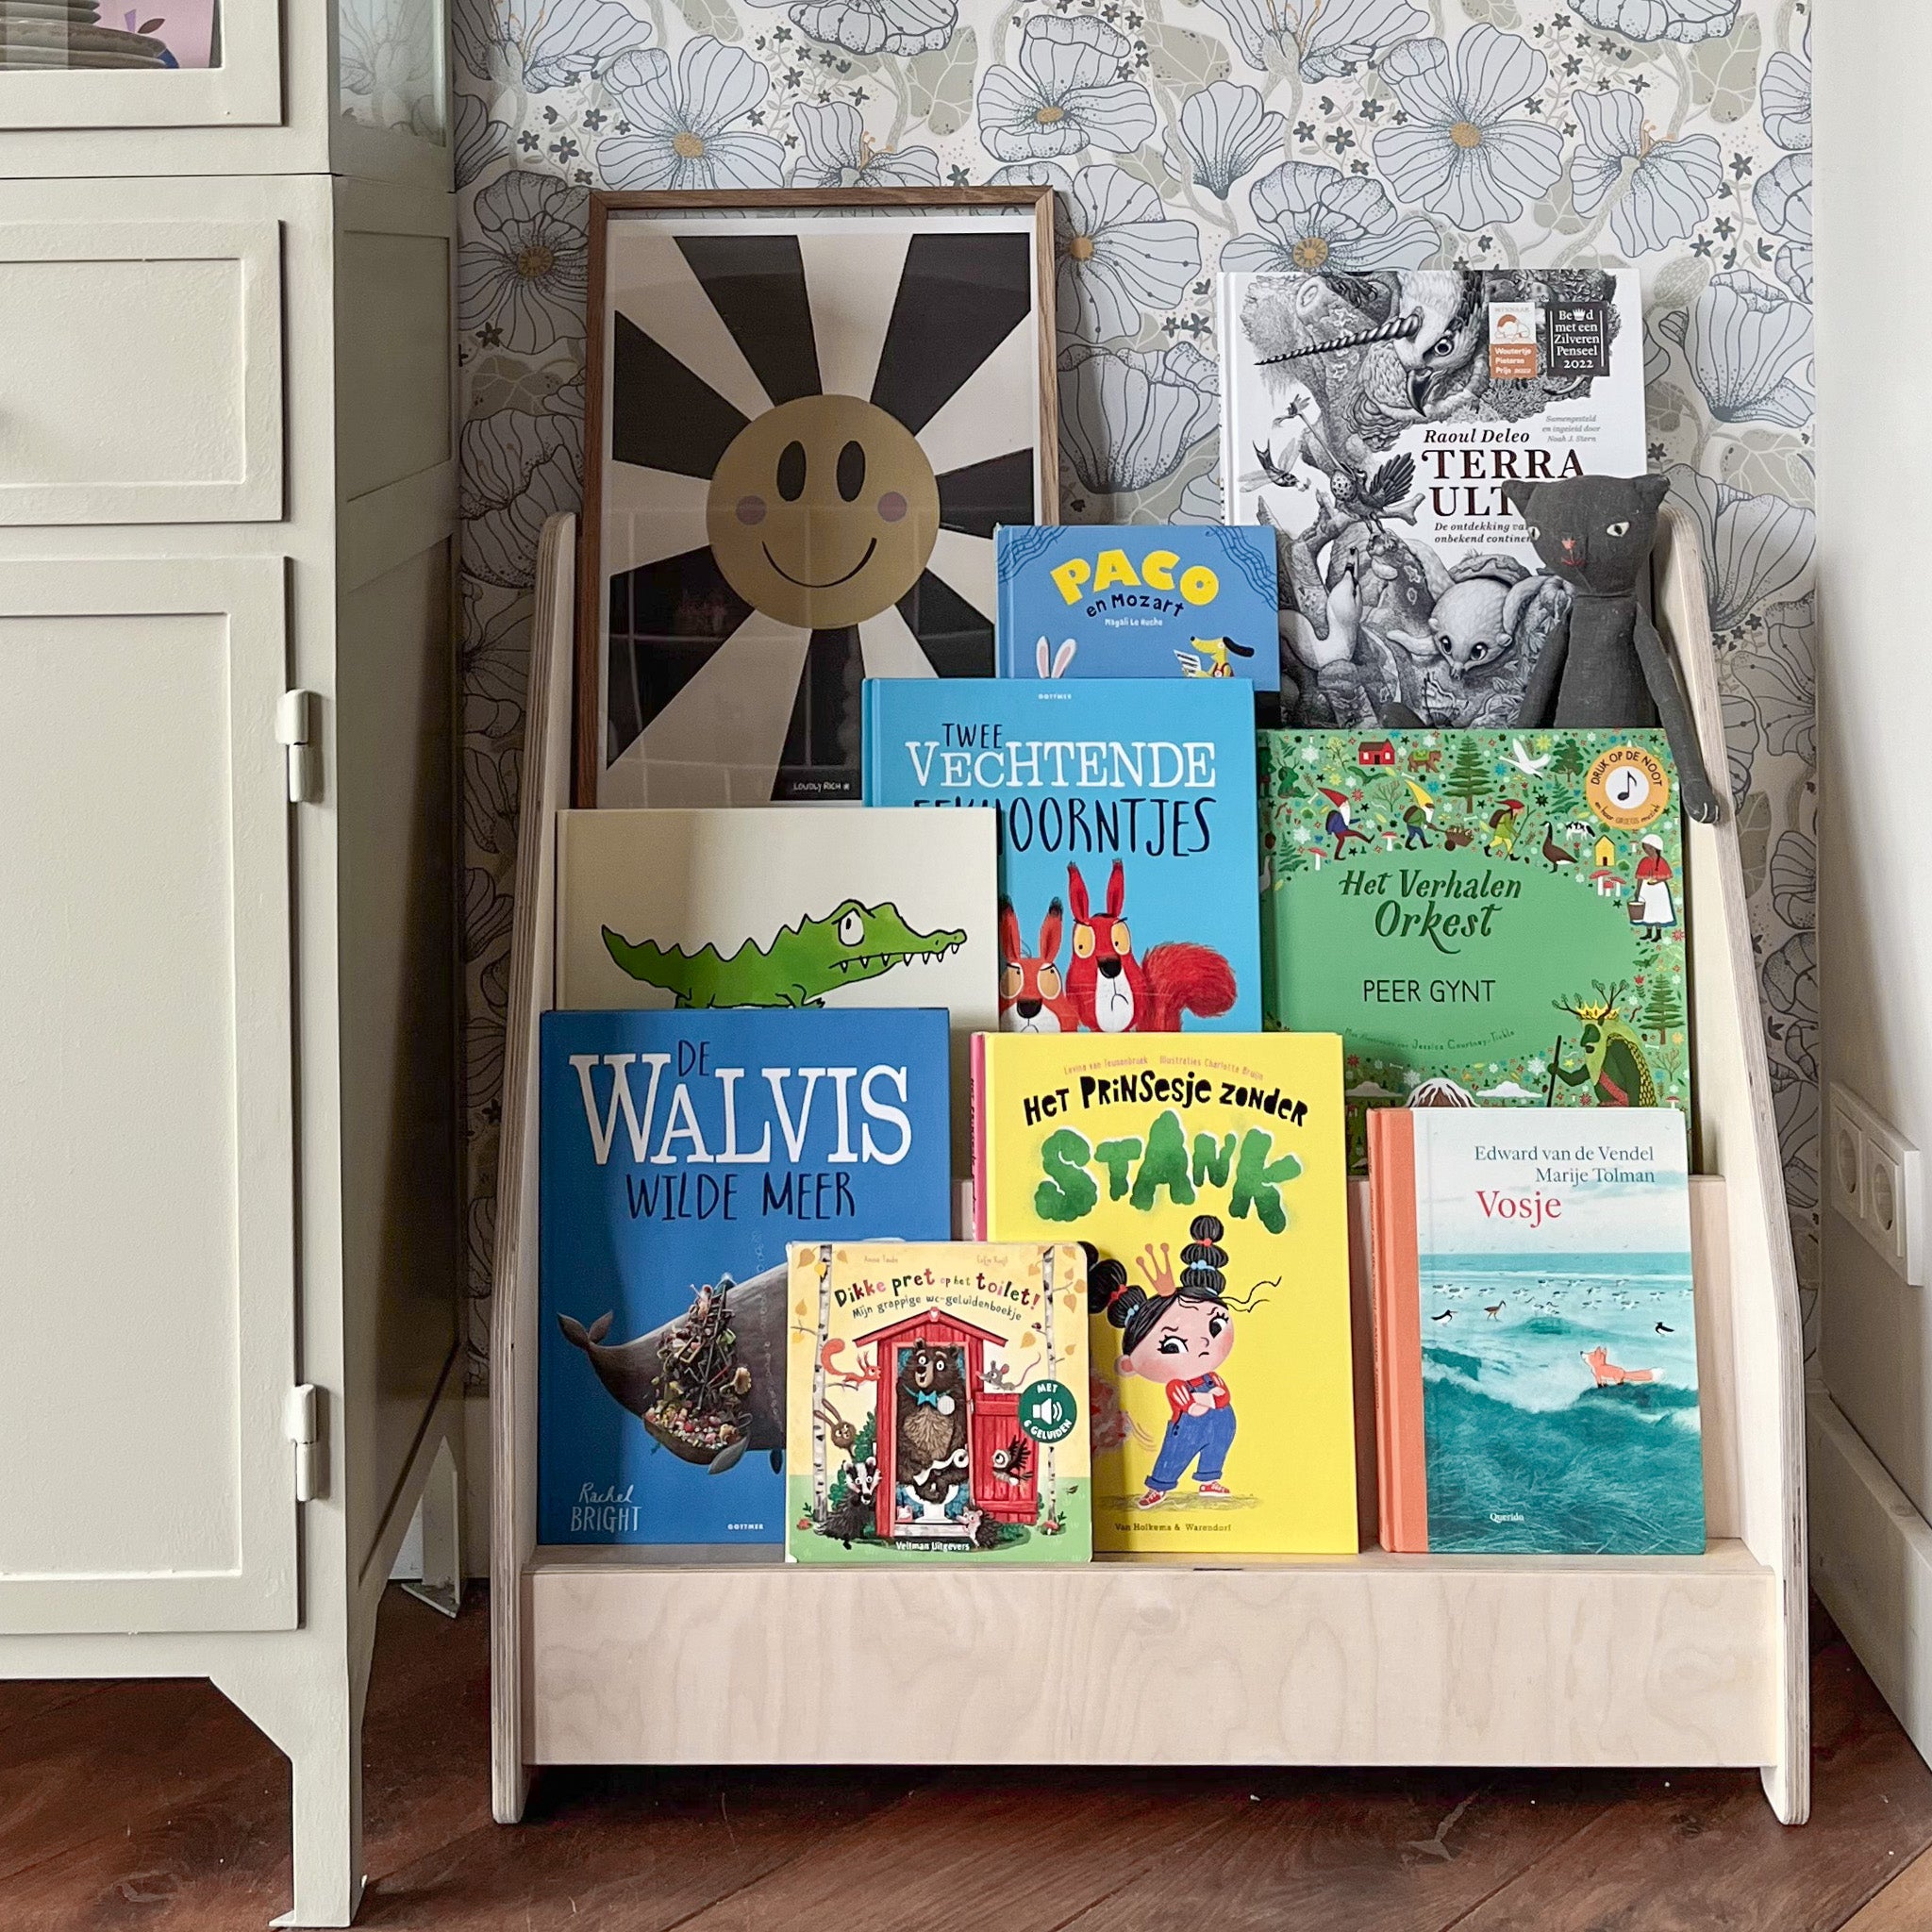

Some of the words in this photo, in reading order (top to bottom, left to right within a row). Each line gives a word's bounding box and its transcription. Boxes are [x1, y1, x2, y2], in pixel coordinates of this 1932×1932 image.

[1554, 333, 1600, 343] Zilveren
[1555, 324, 1576, 332] met
[1557, 345, 1598, 357] Penseel
[1563, 359, 1594, 369] 2022
[1423, 429, 1476, 443] Raoul
[1481, 428, 1530, 443] Deleo
[1421, 448, 1585, 479] TERRA
[1428, 486, 1514, 517] ULT
[1434, 522, 1449, 530] De
[1450, 522, 1510, 533] ontdekking
[1434, 534, 1484, 543] onbekend
[1486, 534, 1532, 543] contine
[1049, 548, 1220, 606] PACO
[1086, 599, 1108, 617] en
[1110, 592, 1185, 617] Mozart
[1105, 616, 1129, 628] Magali
[941, 723, 1003, 749] TWEE
[905, 741, 1217, 788] VECHTENDE
[1591, 758, 1610, 785] DRUK
[1608, 751, 1623, 763] OP
[1625, 750, 1641, 761] DE
[1641, 756, 1662, 787] NOOT
[913, 796, 1217, 857] OORNTJES
[1339, 870, 1393, 896] Het
[1398, 869, 1522, 899] Verhalen
[1374, 899, 1503, 955] Orkest
[1363, 979, 1422, 1003] PEER
[1429, 979, 1496, 1003] GYNT
[677, 1040, 710, 1077] DE
[569, 1053, 912, 1166] WALVIS
[1474, 1145, 1538, 1161] Edward
[1542, 1149, 1571, 1161] van
[1574, 1145, 1594, 1161] de
[1597, 1145, 1654, 1161] Vendel
[1034, 1109, 1303, 1235] STANK
[1536, 1168, 1589, 1188] Marije
[1591, 1167, 1656, 1183] Tolman
[625, 1172, 738, 1221] WILDE
[762, 1171, 855, 1220] MEER
[1475, 1191, 1562, 1228] Vosje
[834, 1279, 887, 1307] Dikke
[891, 1268, 936, 1296] pret
[940, 1277, 952, 1288] op
[953, 1275, 971, 1287] het
[975, 1272, 1041, 1310] toilet!
[852, 1306, 874, 1320] Mijn
[877, 1295, 922, 1314] grappige
[925, 1294, 1022, 1321] wc-geluidenboekje
[1037, 1382, 1058, 1393] MET
[1030, 1418, 1073, 1440] GELUIDEN
[578, 1482, 634, 1504] Rachel
[571, 1506, 641, 1533] BRIGHT
[1133, 1523, 1172, 1531] Holkema
[1489, 1512, 1524, 1524] Querido
[896, 1541, 930, 1551] Veltman
[931, 1541, 970, 1552] Uitgevers
